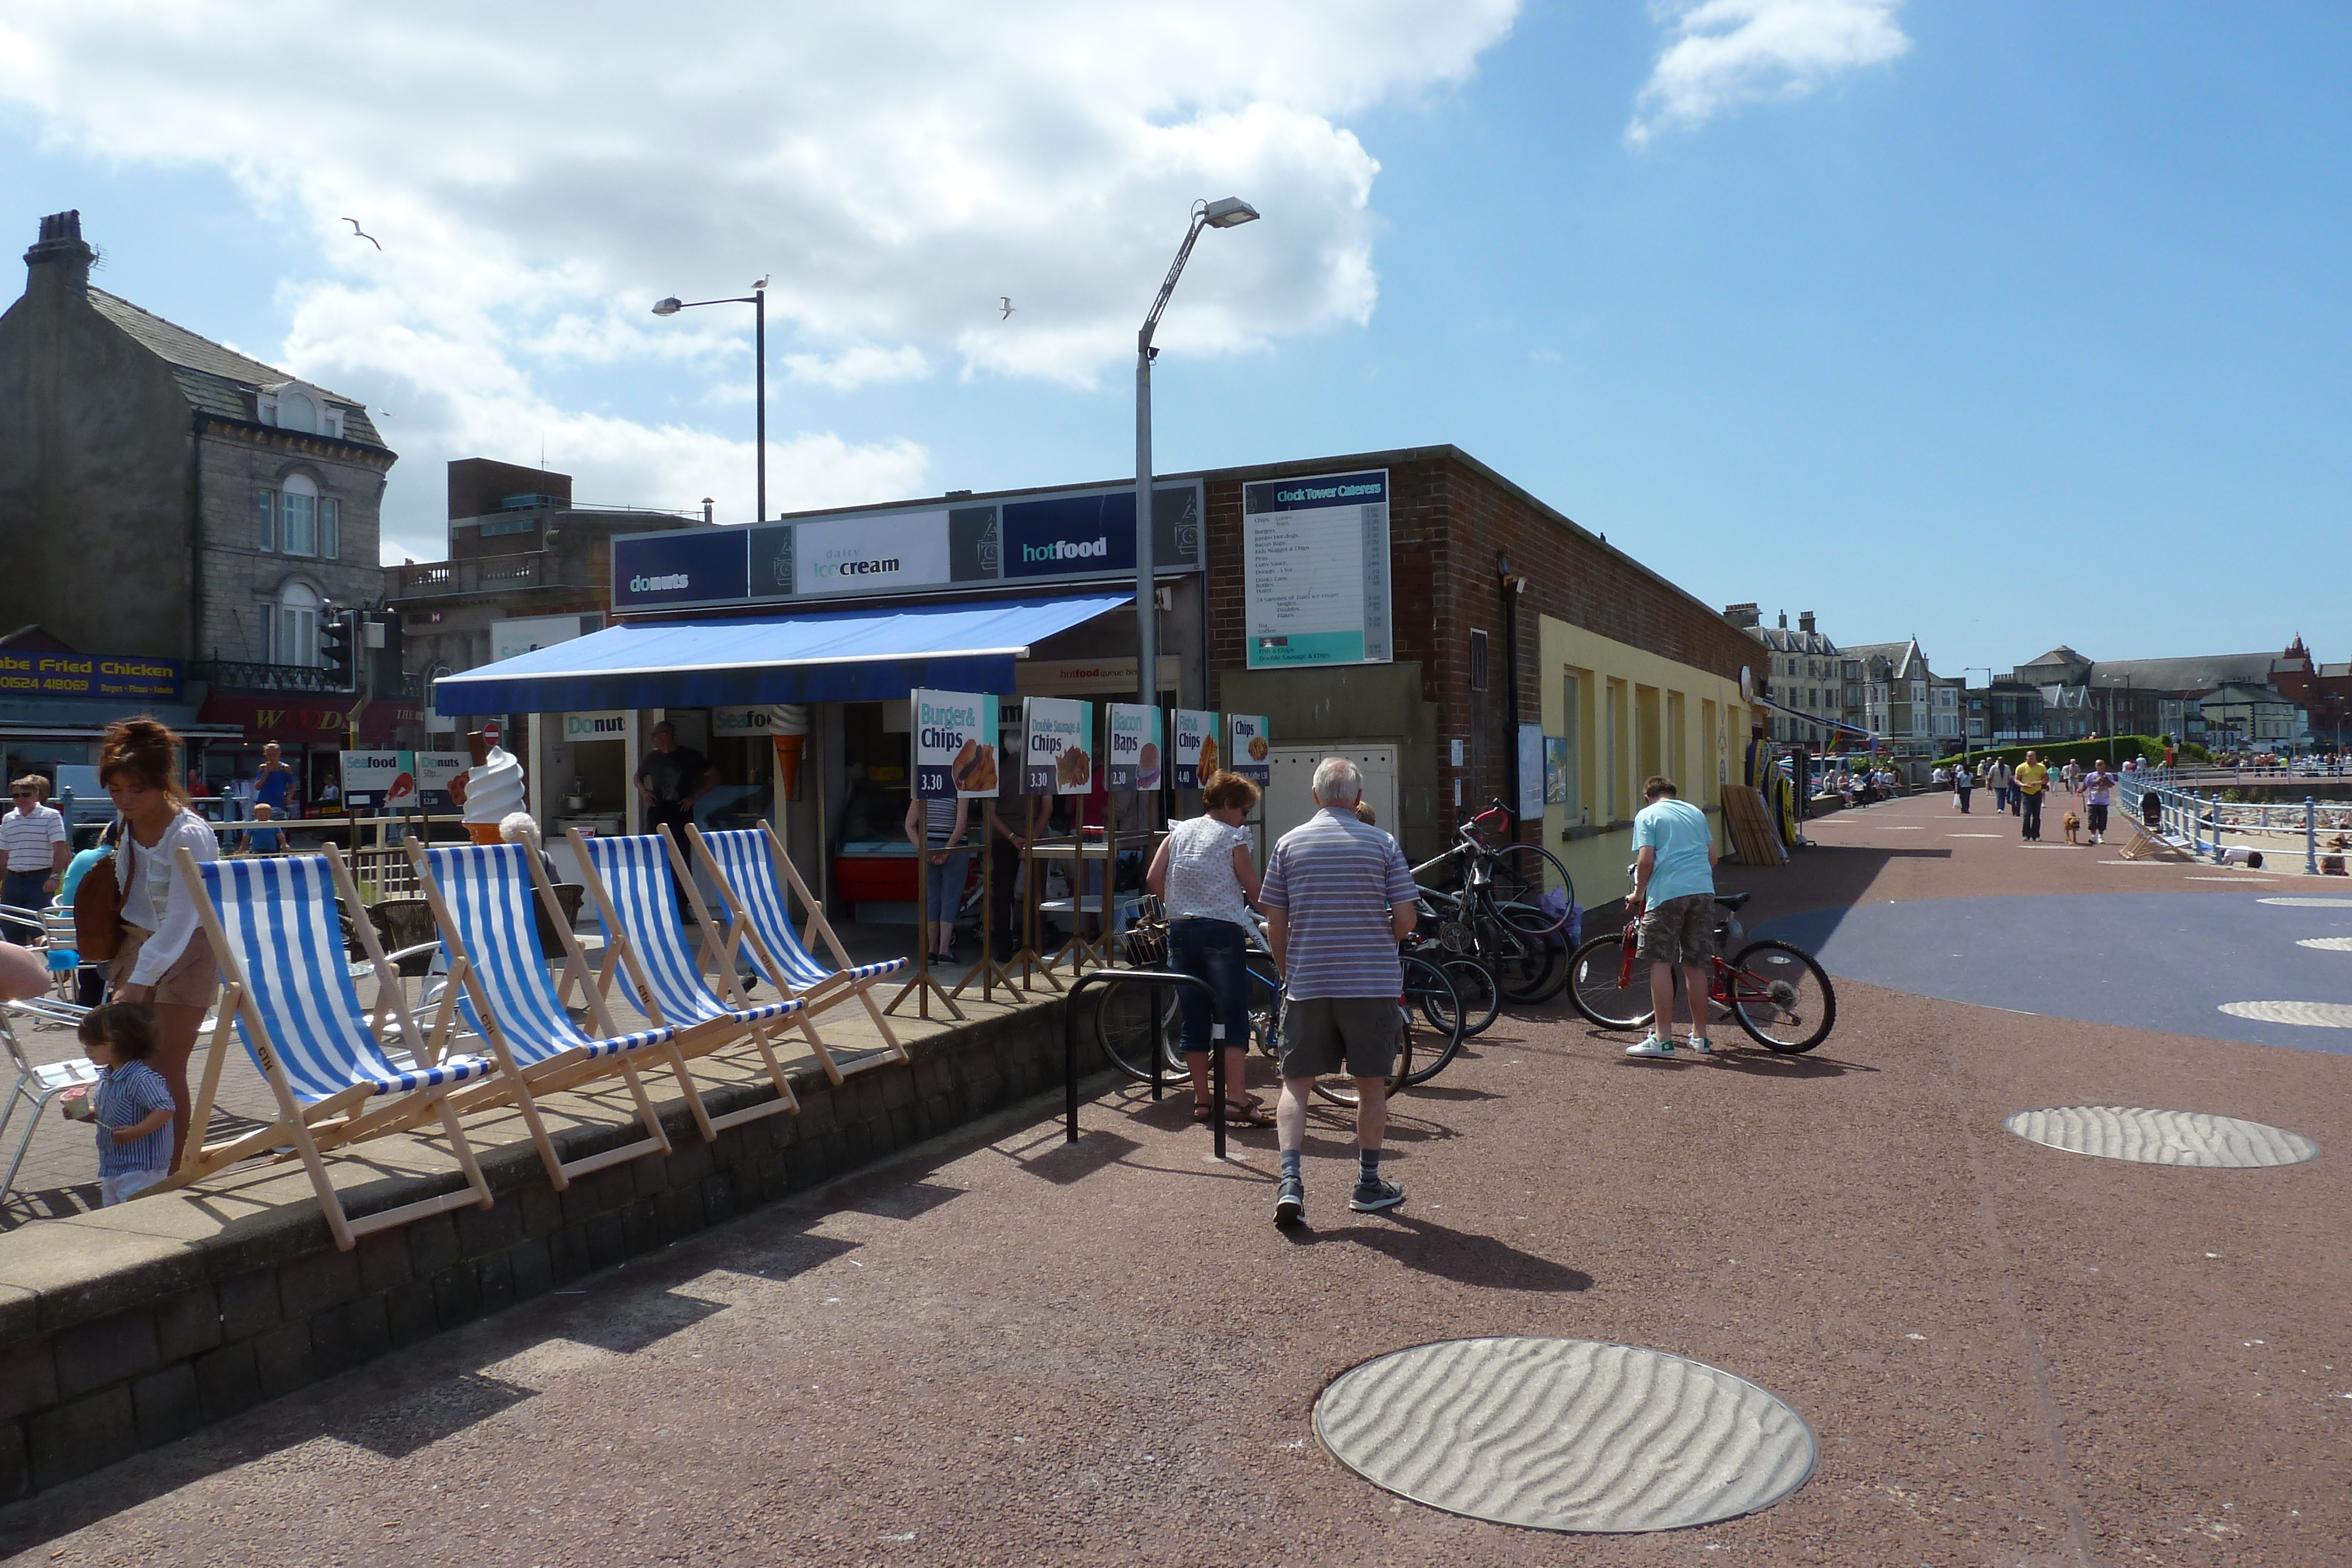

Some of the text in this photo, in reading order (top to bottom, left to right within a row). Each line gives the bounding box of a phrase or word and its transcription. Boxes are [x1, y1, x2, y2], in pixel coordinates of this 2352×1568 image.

[1277, 482, 1381, 502] Clock Tower Caterers
[826, 548, 860, 558] dairy
[630, 573, 689, 592] donuts
[39, 658, 92, 673] Fried
[100, 662, 173, 677] Chicken
[43, 678, 89, 691] 418069
[568, 716, 626, 734] Donut
[1032, 719, 1053, 732] Double
[1054, 721, 1075, 735] Sausage
[1114, 711, 1142, 732] Bacon
[1235, 721, 1254, 738] Chips
[921, 727, 963, 752] Chips
[1031, 734, 1062, 754] Chips
[1114, 733, 1138, 754] Baps
[1179, 733, 1200, 750] Chips
[346, 756, 397, 769] Seafood
[422, 757, 459, 768] Donuts
[921, 774, 943, 791] 3.30
[1030, 772, 1047, 788] 3.30
[1112, 771, 1126, 785] 2.30
[1178, 771, 1190, 783] 4.40
[638, 985, 650, 1004] CTH
